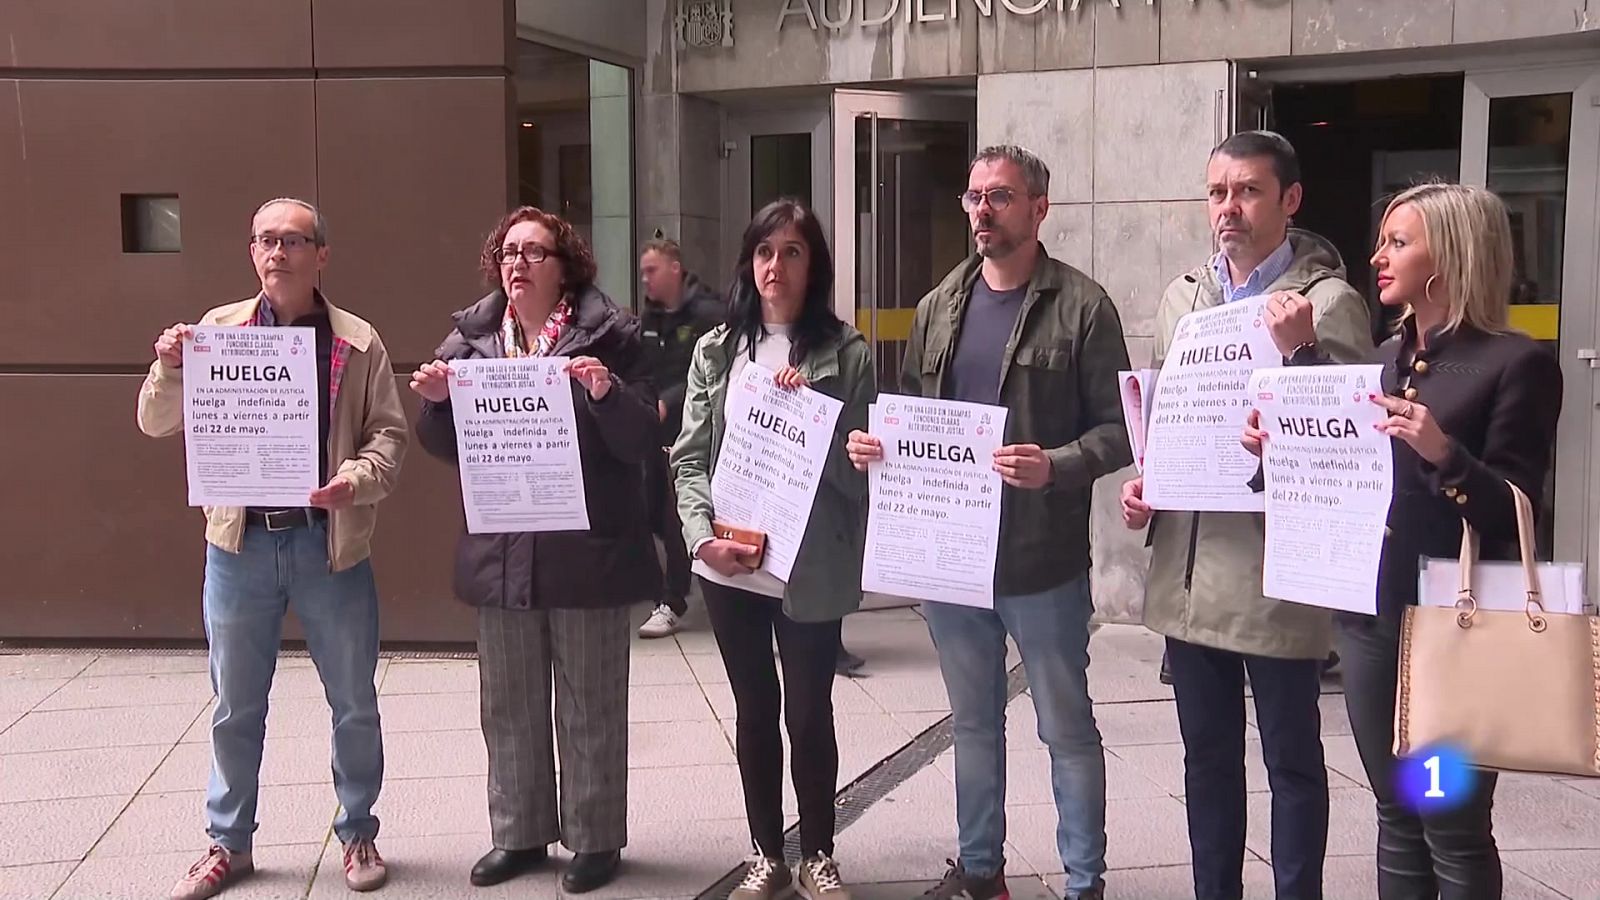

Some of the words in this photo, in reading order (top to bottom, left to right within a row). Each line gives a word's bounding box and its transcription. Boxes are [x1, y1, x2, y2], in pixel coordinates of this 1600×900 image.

[775, 0, 1086, 32] AUDIN
[1179, 343, 1252, 366] HUELGA
[211, 365, 291, 381] HUELGA
[1198, 381, 1245, 392] indefinida
[192, 398, 225, 408] Huelga
[238, 398, 286, 407] indefinida
[298, 398, 309, 407] de
[475, 397, 549, 413] HUELGA
[1192, 398, 1226, 407] viernes
[192, 411, 218, 420] lunes
[233, 412, 268, 420] viernes
[283, 412, 309, 422] partir
[1171, 415, 1181, 423] 22
[1183, 414, 1194, 423] de
[1197, 415, 1226, 424] mayo.
[193, 424, 207, 433] del
[211, 425, 221, 433] 22
[225, 424, 236, 433] de
[239, 426, 268, 435] mayo.
[464, 429, 493, 438] Huelga
[504, 428, 546, 436] indefinida
[558, 428, 568, 436] de
[748, 406, 805, 448] HUELGA
[1278, 416, 1358, 438] HUELGA
[465, 442, 488, 450] lunes
[501, 441, 532, 449] viernes
[546, 441, 570, 450] partir
[898, 440, 976, 464] HUELGA
[466, 455, 479, 463] del
[495, 454, 505, 462] de
[728, 432, 752, 450] Huelga
[803, 469, 812, 479] de
[732, 463, 741, 473] 22
[743, 467, 752, 478] de
[1269, 456, 1299, 469] Huelga
[1372, 461, 1383, 472] de
[788, 476, 808, 492] partir
[880, 472, 911, 485] Huelga
[922, 476, 968, 491] indefinida
[981, 484, 992, 494] de
[1272, 472, 1295, 484] lunes
[1309, 476, 1342, 486] viernes
[1356, 481, 1383, 491] partir
[880, 486, 903, 497] lunes
[918, 492, 950, 504] viernes
[965, 499, 992, 509] partir
[1272, 489, 1286, 500] del
[1288, 492, 1298, 500] 22
[1301, 492, 1312, 502] de
[1314, 494, 1341, 506] mayo.
[878, 502, 892, 511] del
[894, 504, 904, 512] 22
[907, 504, 918, 514] de
[921, 509, 949, 520] mayo.
